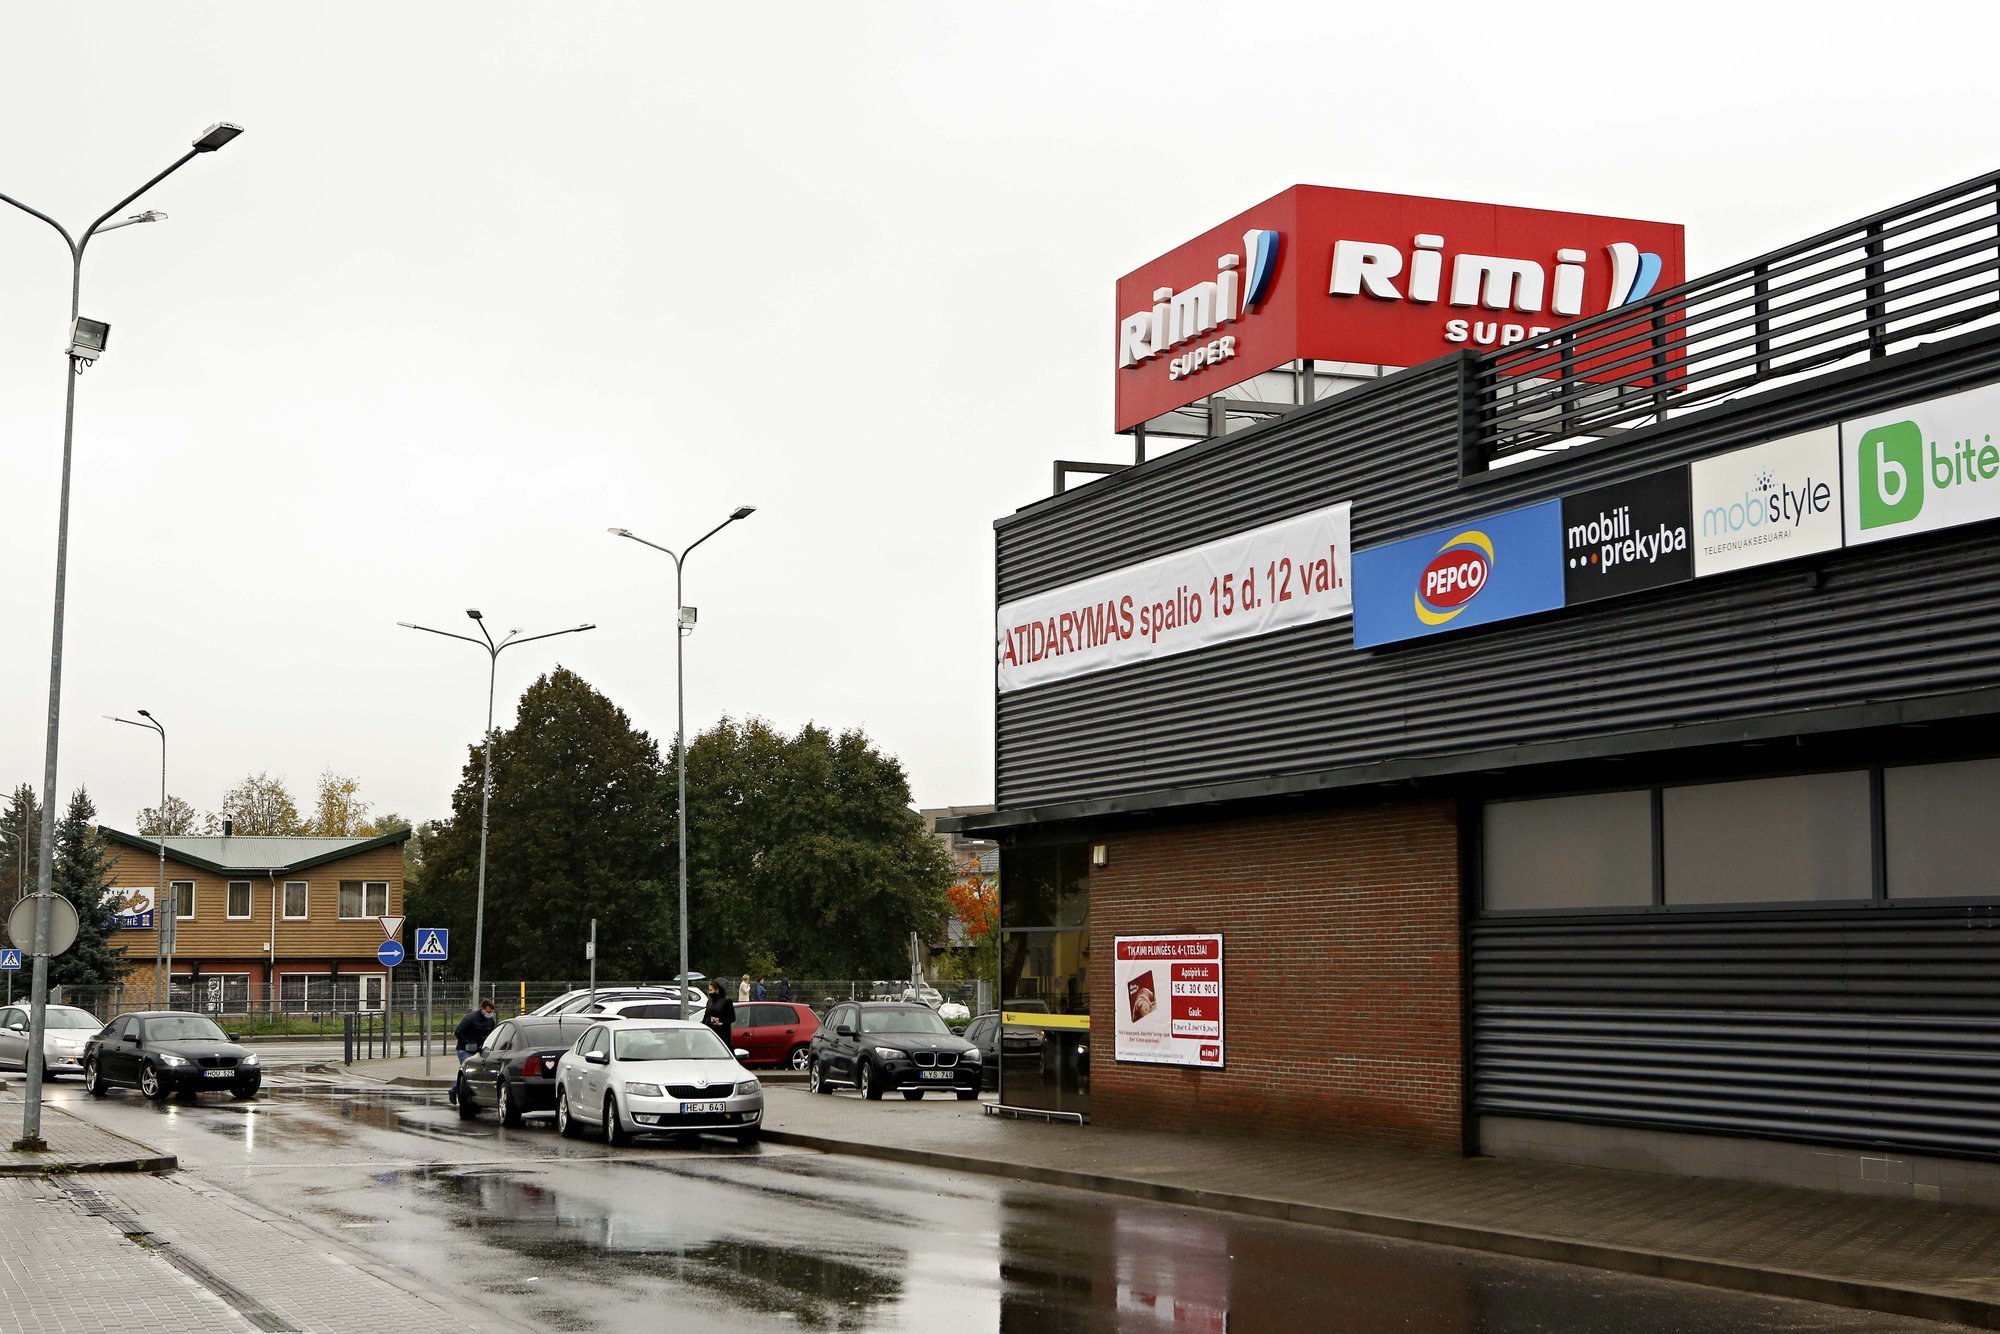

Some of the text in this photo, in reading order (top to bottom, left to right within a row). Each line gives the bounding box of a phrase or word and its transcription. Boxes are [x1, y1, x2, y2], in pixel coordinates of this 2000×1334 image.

[1329, 234, 1588, 317] Rimi
[1119, 254, 1240, 369] Rimi
[1169, 335, 1236, 381] SUPER
[1931, 434, 2000, 490] bitė
[1568, 505, 1631, 549] mobili
[1703, 477, 1831, 538] mobistyle
[1601, 523, 1687, 574] prekyba
[1426, 559, 1483, 597] PEPCO
[1002, 544, 1344, 667] ATIDARYMAS spalio 15 d. 12 val.
[1148, 943, 1171, 956] PLUNGĖS
[1172, 945, 1177, 955] G.
[1181, 967, 1201, 979] Apsipirk
[1188, 1007, 1202, 1017] Gauk:
[686, 1103, 724, 1112] HEJ 643
